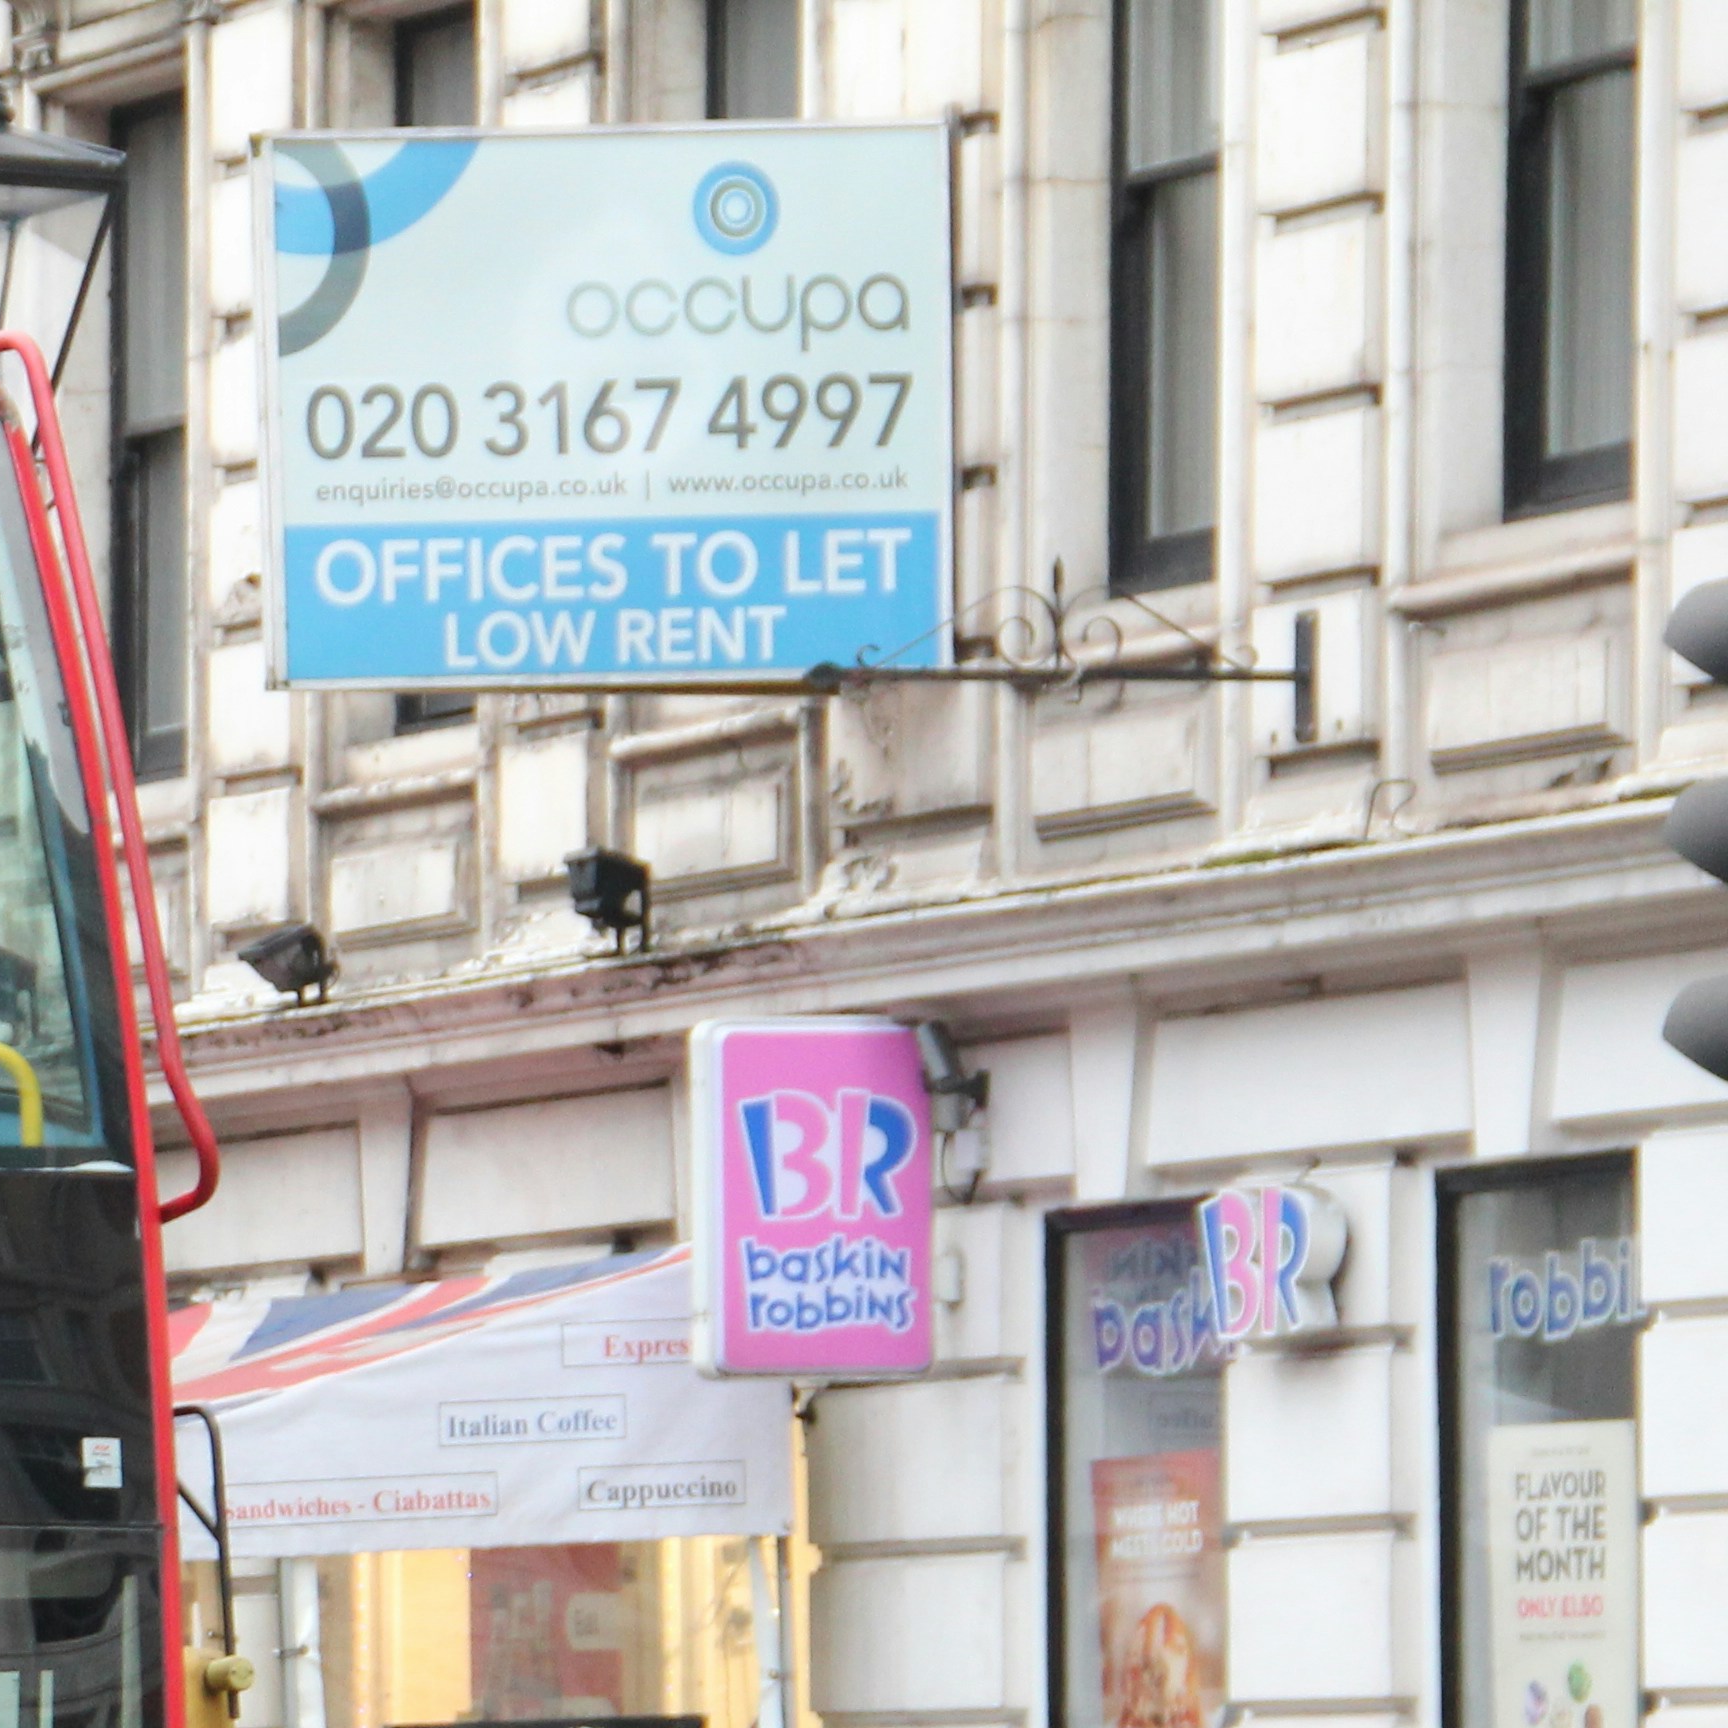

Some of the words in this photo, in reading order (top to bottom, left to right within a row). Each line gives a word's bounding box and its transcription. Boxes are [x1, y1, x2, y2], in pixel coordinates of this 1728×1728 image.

[566, 272, 911, 353] occupa
[306, 382, 460, 460] 020
[483, 377, 683, 458] 3167
[707, 372, 913, 450] 4997
[316, 472, 628, 506] enquiries@occupa.co.uk
[667, 465, 908, 497] www.occupa.co.uk
[314, 532, 629, 607] OFFICES
[649, 528, 759, 598] TO
[784, 526, 912, 596] LET
[445, 609, 597, 669] LOW
[615, 604, 787, 666] RENT
[737, 1087, 918, 1221] BR
[744, 1235, 908, 1283] baskin
[1200, 1188, 1310, 1340] BR
[748, 1286, 912, 1330] robbins
[1488, 1236, 1634, 1342] robbi
[604, 1334, 691, 1364] Expres
[447, 1412, 529, 1439] Italian
[537, 1410, 617, 1436] Coffee
[372, 1488, 492, 1514] Ciabattas
[586, 1475, 738, 1509] Cappuccino
[1515, 1470, 1607, 1501] FLAVOUR
[1515, 1507, 1547, 1541] OF
[1556, 1504, 1608, 1541] THE
[1516, 1547, 1606, 1582] MONTH
